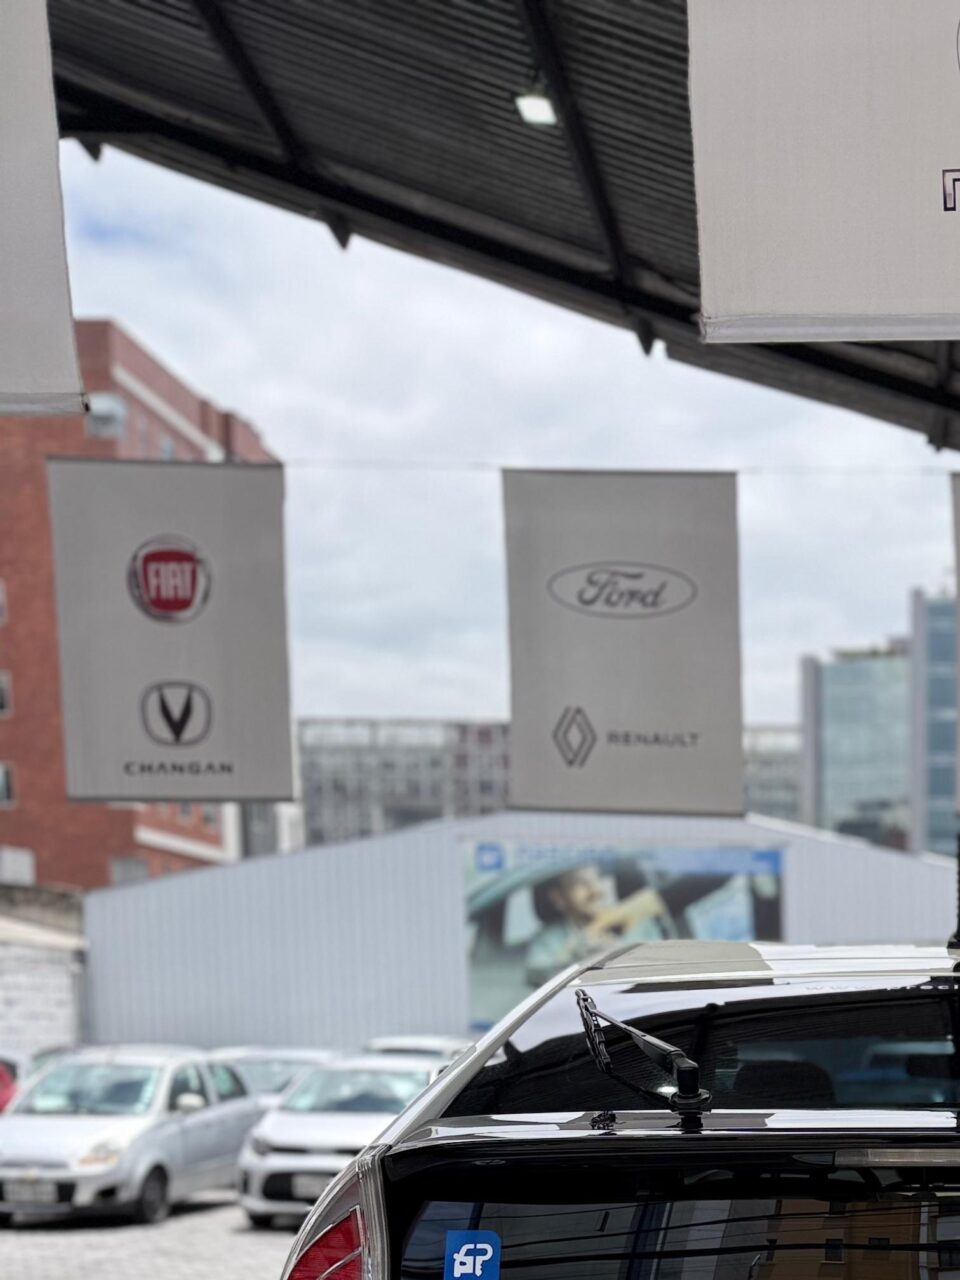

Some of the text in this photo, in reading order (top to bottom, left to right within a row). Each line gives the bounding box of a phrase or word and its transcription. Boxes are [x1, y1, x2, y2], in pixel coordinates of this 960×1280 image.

[147, 561, 193, 600] FIAT
[577, 569, 668, 608] Ford
[606, 731, 700, 749] RENAULT
[123, 761, 234, 777] CHANGAN
